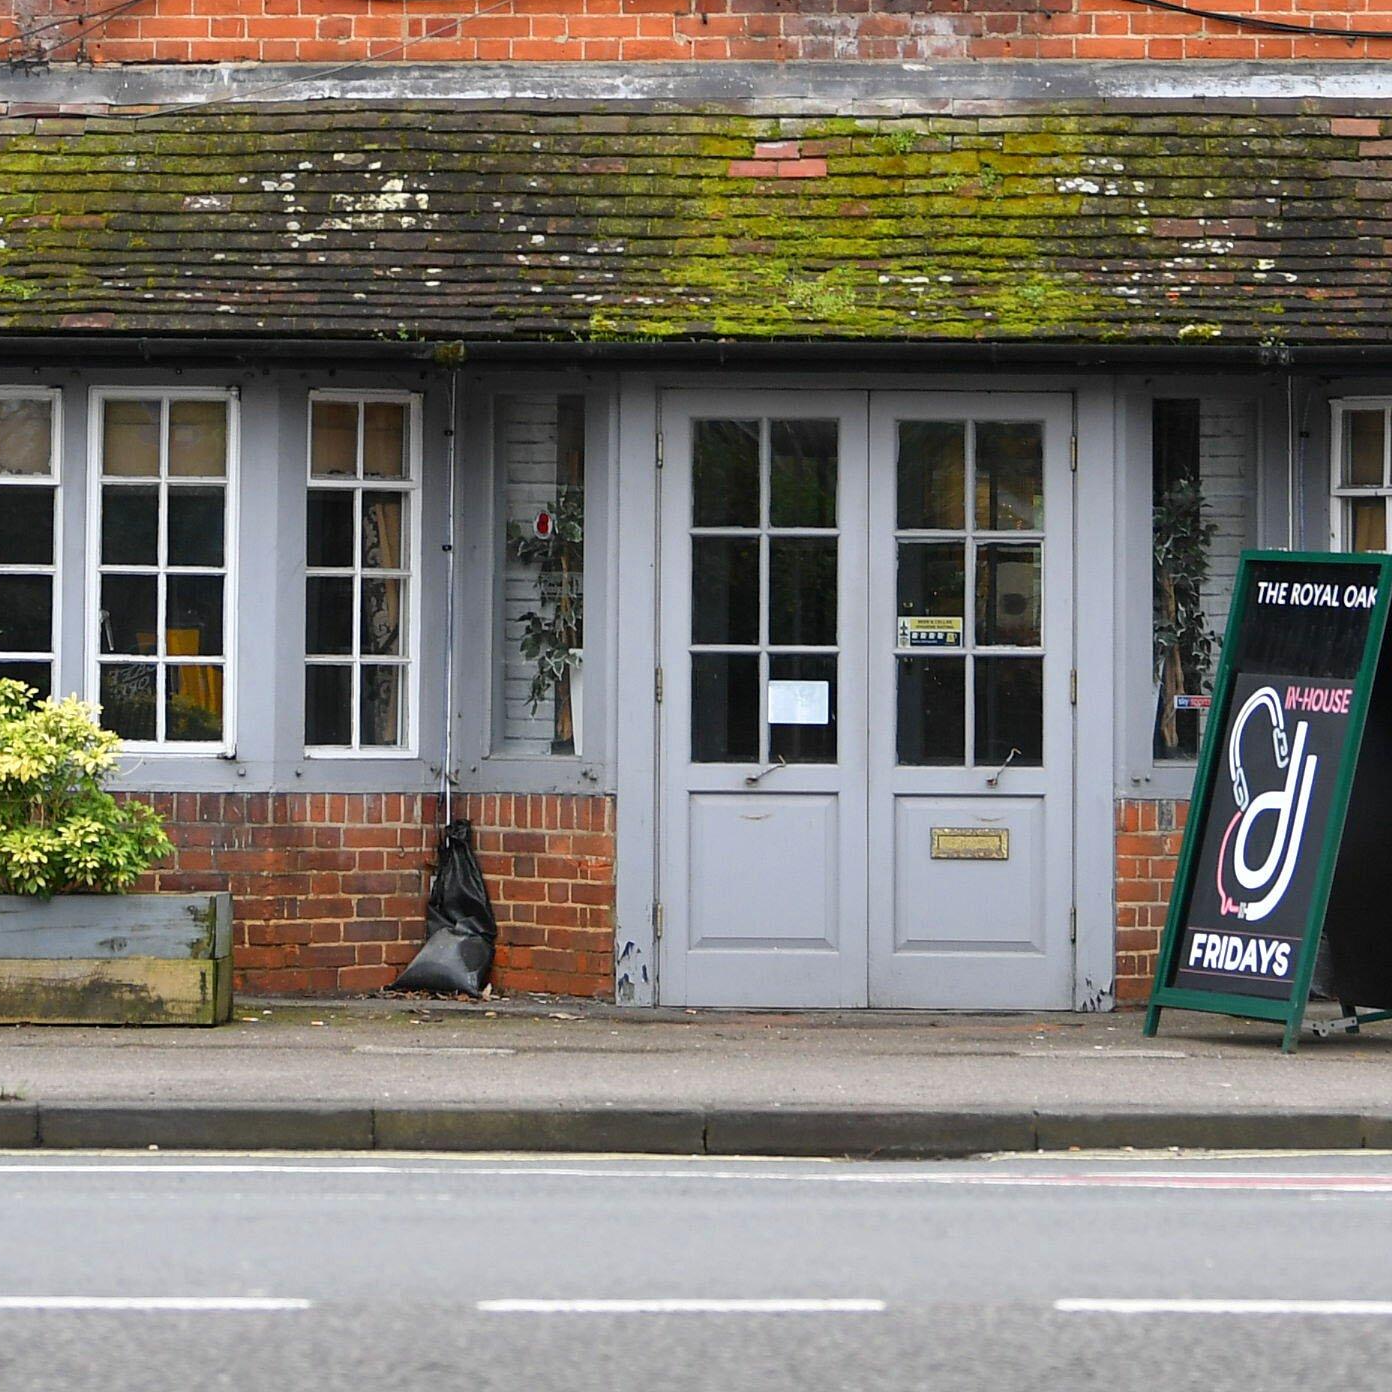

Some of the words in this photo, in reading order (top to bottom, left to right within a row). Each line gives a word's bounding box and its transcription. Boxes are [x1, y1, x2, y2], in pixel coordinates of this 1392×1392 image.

[1257, 582, 1288, 605] THE
[1290, 583, 1339, 607] ROYAL
[1284, 686, 1353, 714] IN-HOUSE
[1188, 932, 1292, 978] FRIDAYS
